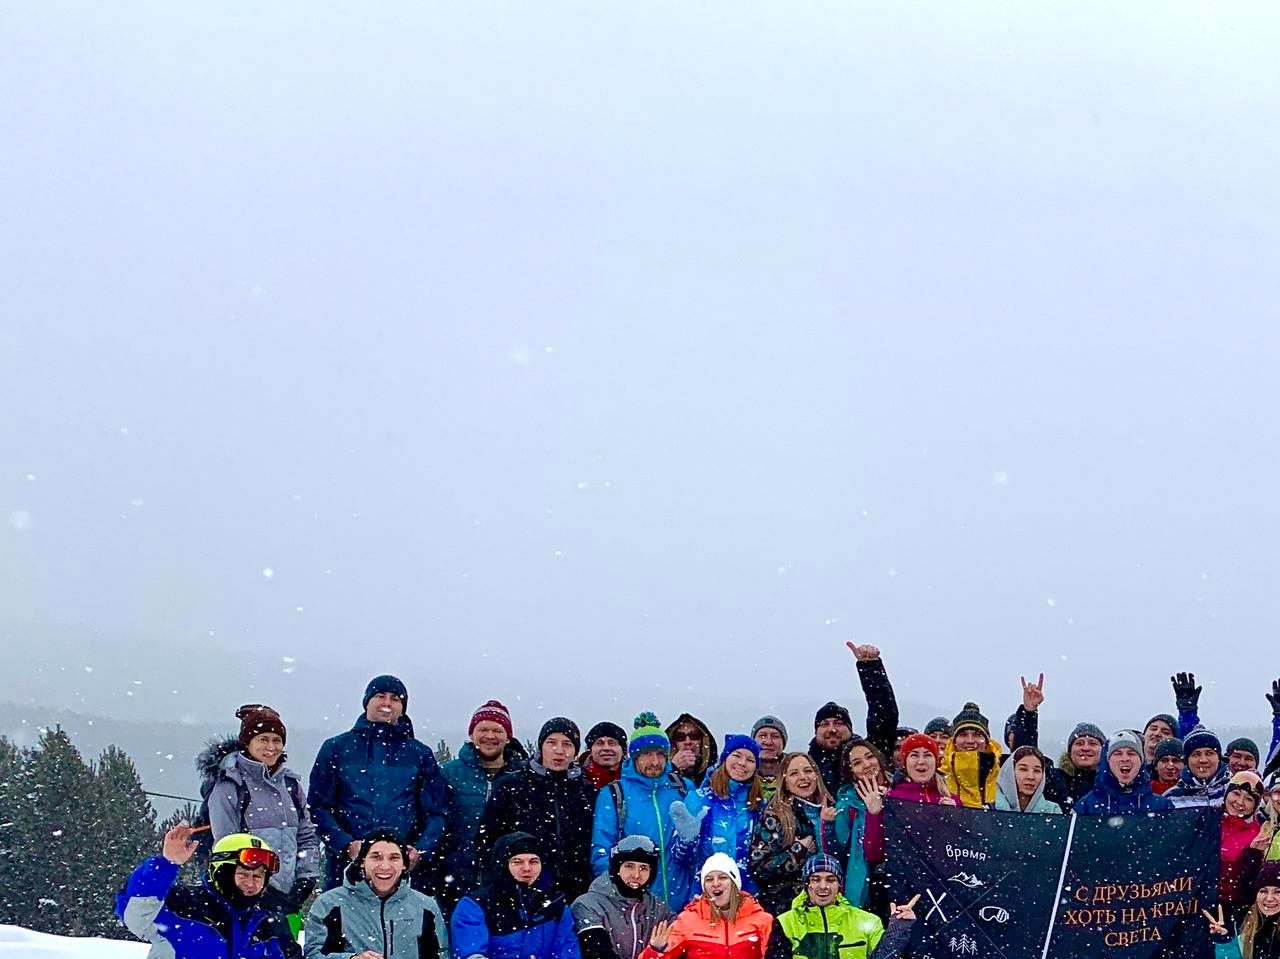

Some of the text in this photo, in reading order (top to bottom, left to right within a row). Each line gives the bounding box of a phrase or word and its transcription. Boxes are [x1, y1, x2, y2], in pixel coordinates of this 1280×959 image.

[1075, 876, 1194, 905] С ДРУЗЬЯМИ
[1065, 908, 1116, 925] ХОТЬ
[1121, 906, 1148, 923] НА
[1104, 926, 1161, 946] СВЕТА
